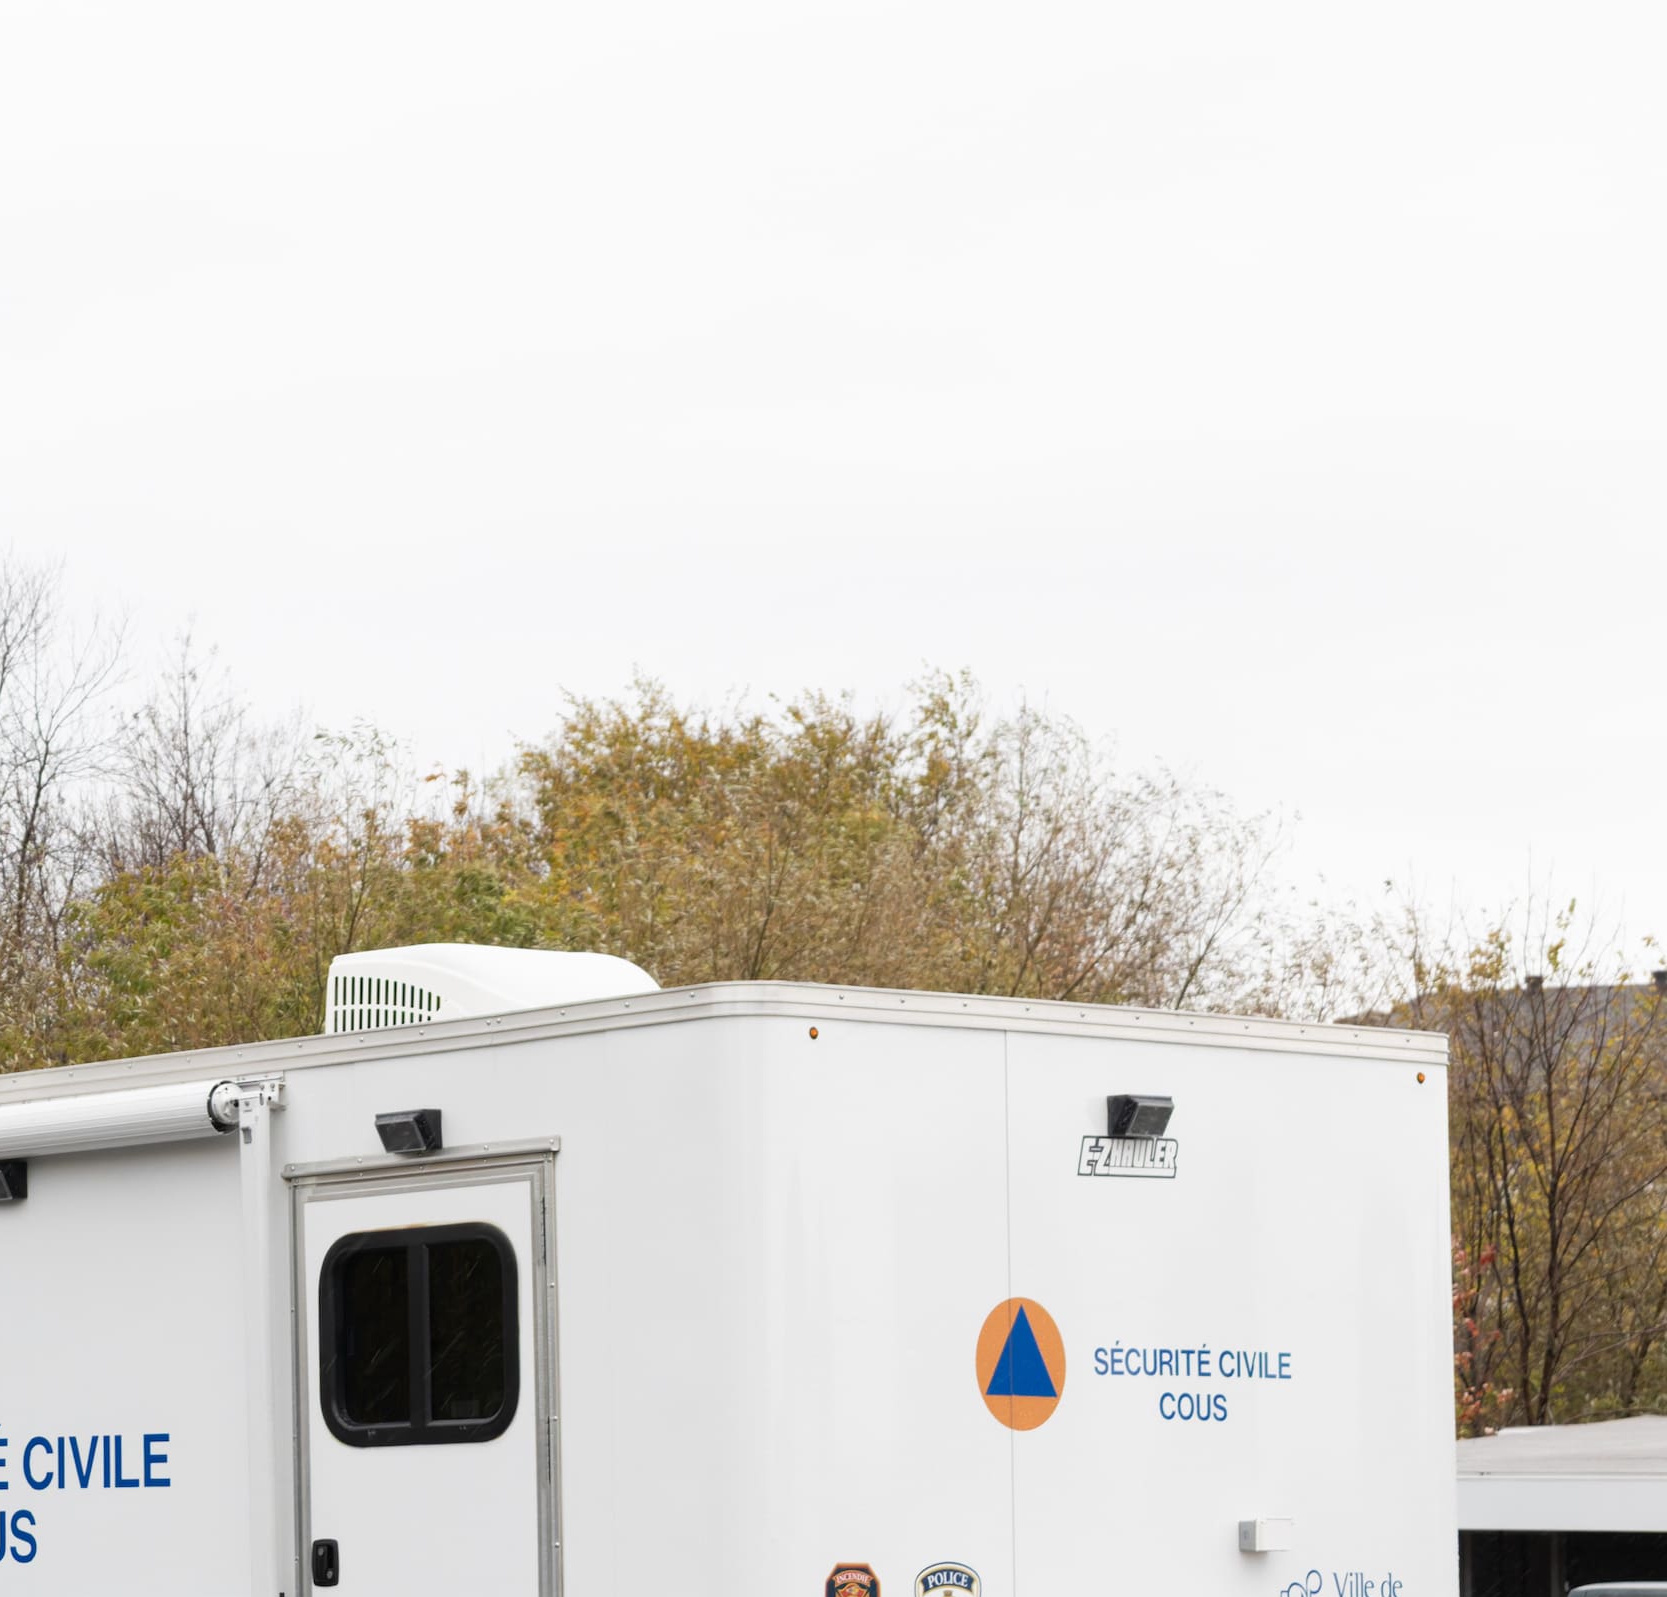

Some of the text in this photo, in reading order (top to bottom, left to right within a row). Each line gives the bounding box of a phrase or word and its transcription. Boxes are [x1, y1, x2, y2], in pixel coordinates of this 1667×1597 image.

[1094, 1340, 1292, 1379] SÉCURITÉ CIVILE
[1159, 1392, 1228, 1421] COUS
[23, 1433, 171, 1491] CIVILE
[927, 1570, 969, 1589] POLICE
